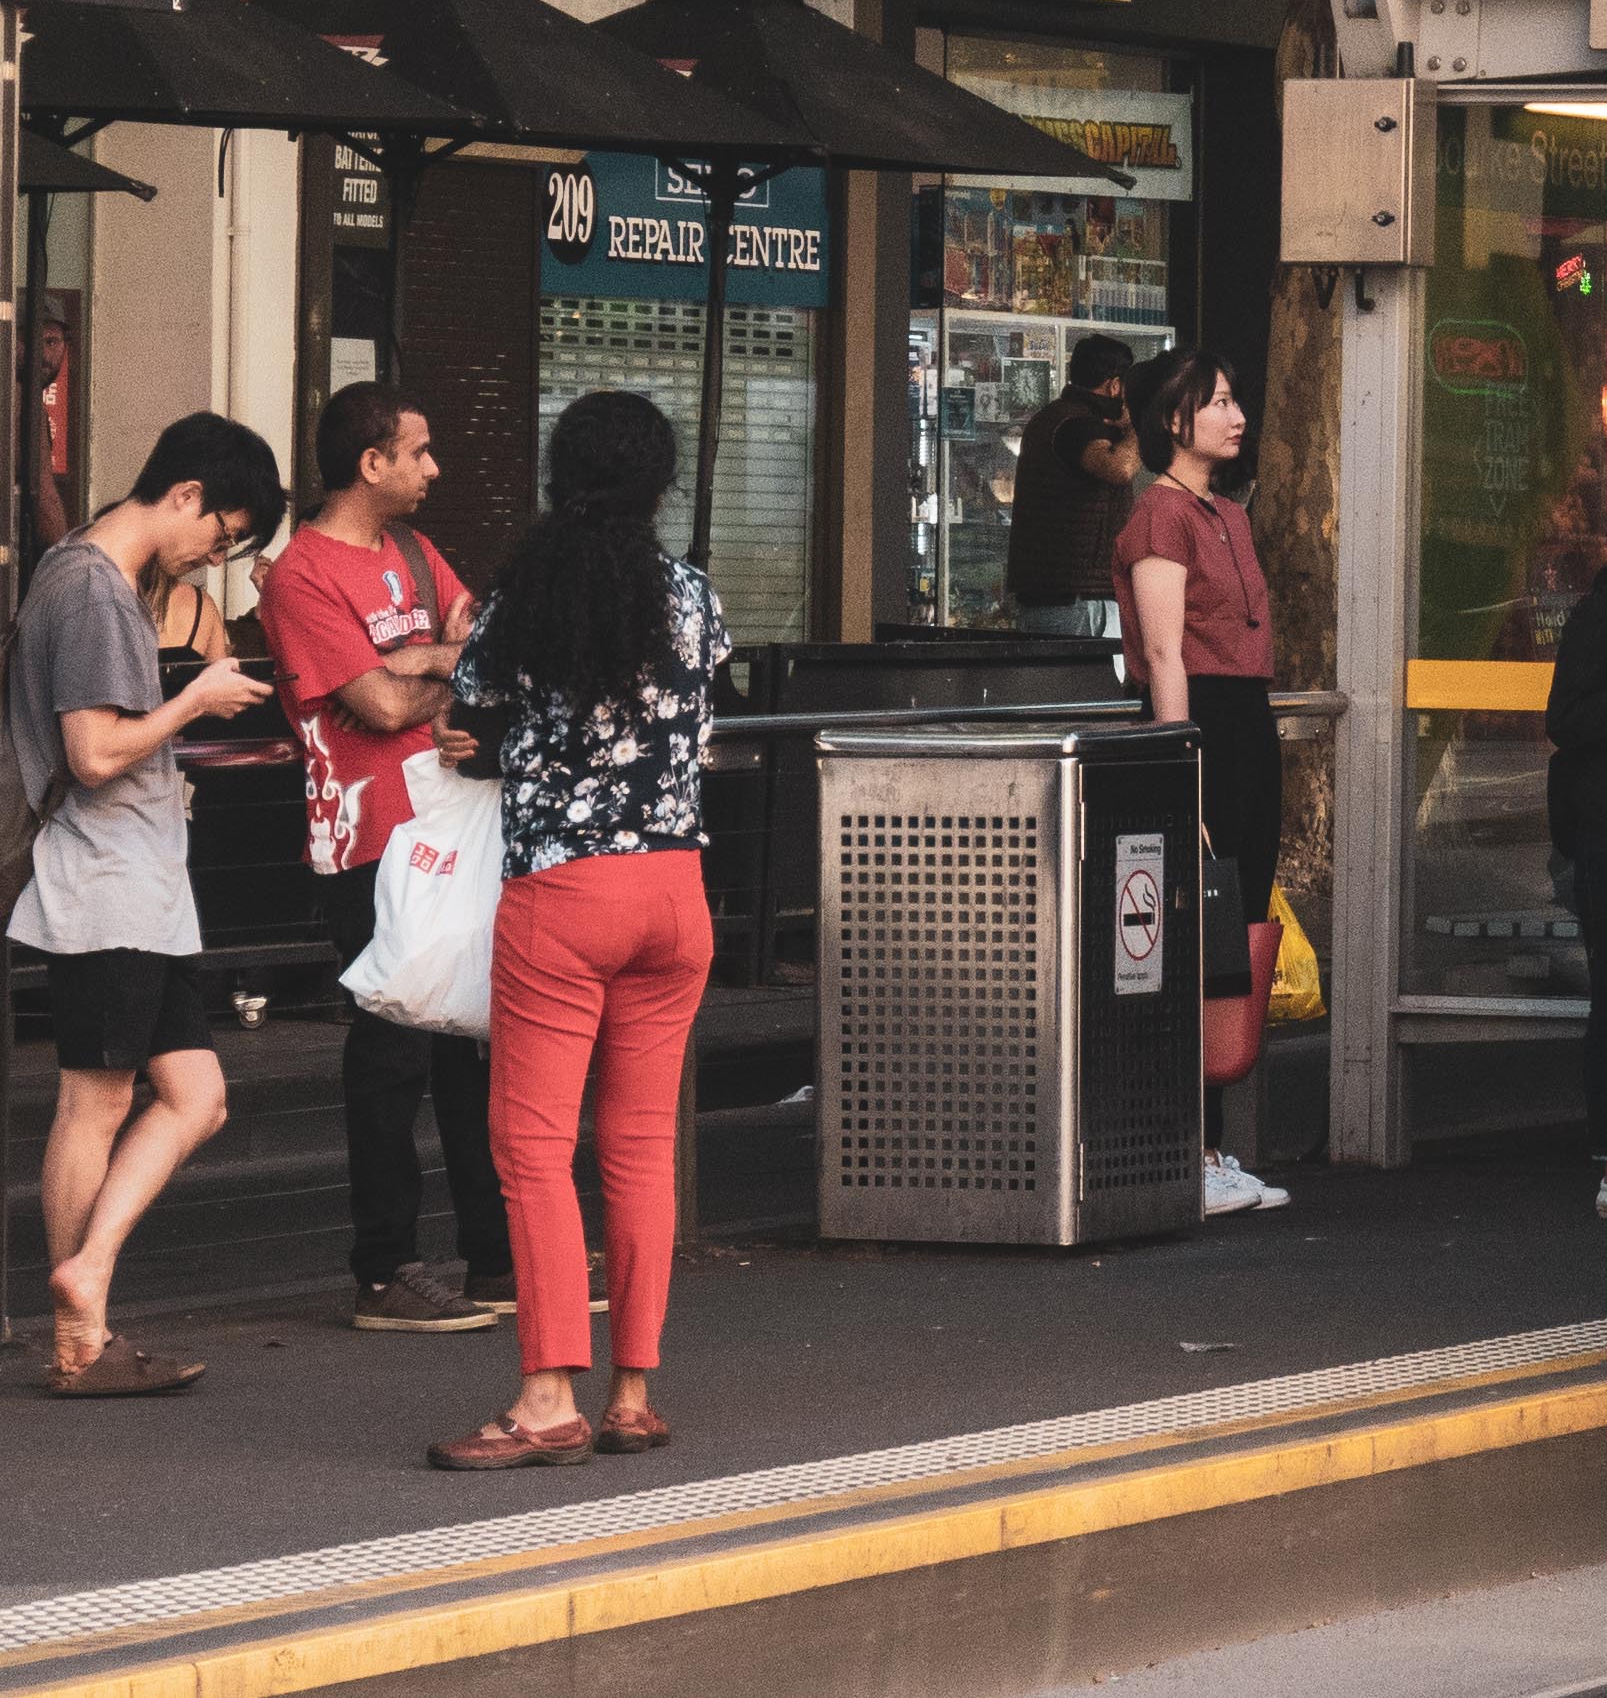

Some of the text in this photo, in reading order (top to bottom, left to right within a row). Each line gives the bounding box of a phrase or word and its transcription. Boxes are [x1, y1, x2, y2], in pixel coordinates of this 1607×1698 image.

[342, 177, 378, 204] FITTED
[333, 212, 384, 229] TO ALL MODELS
[547, 171, 595, 244] 209
[607, 215, 705, 264] REPAIR
[1483, 456, 1530, 491] ZONE
[1130, 844, 1162, 856] No Smoking
